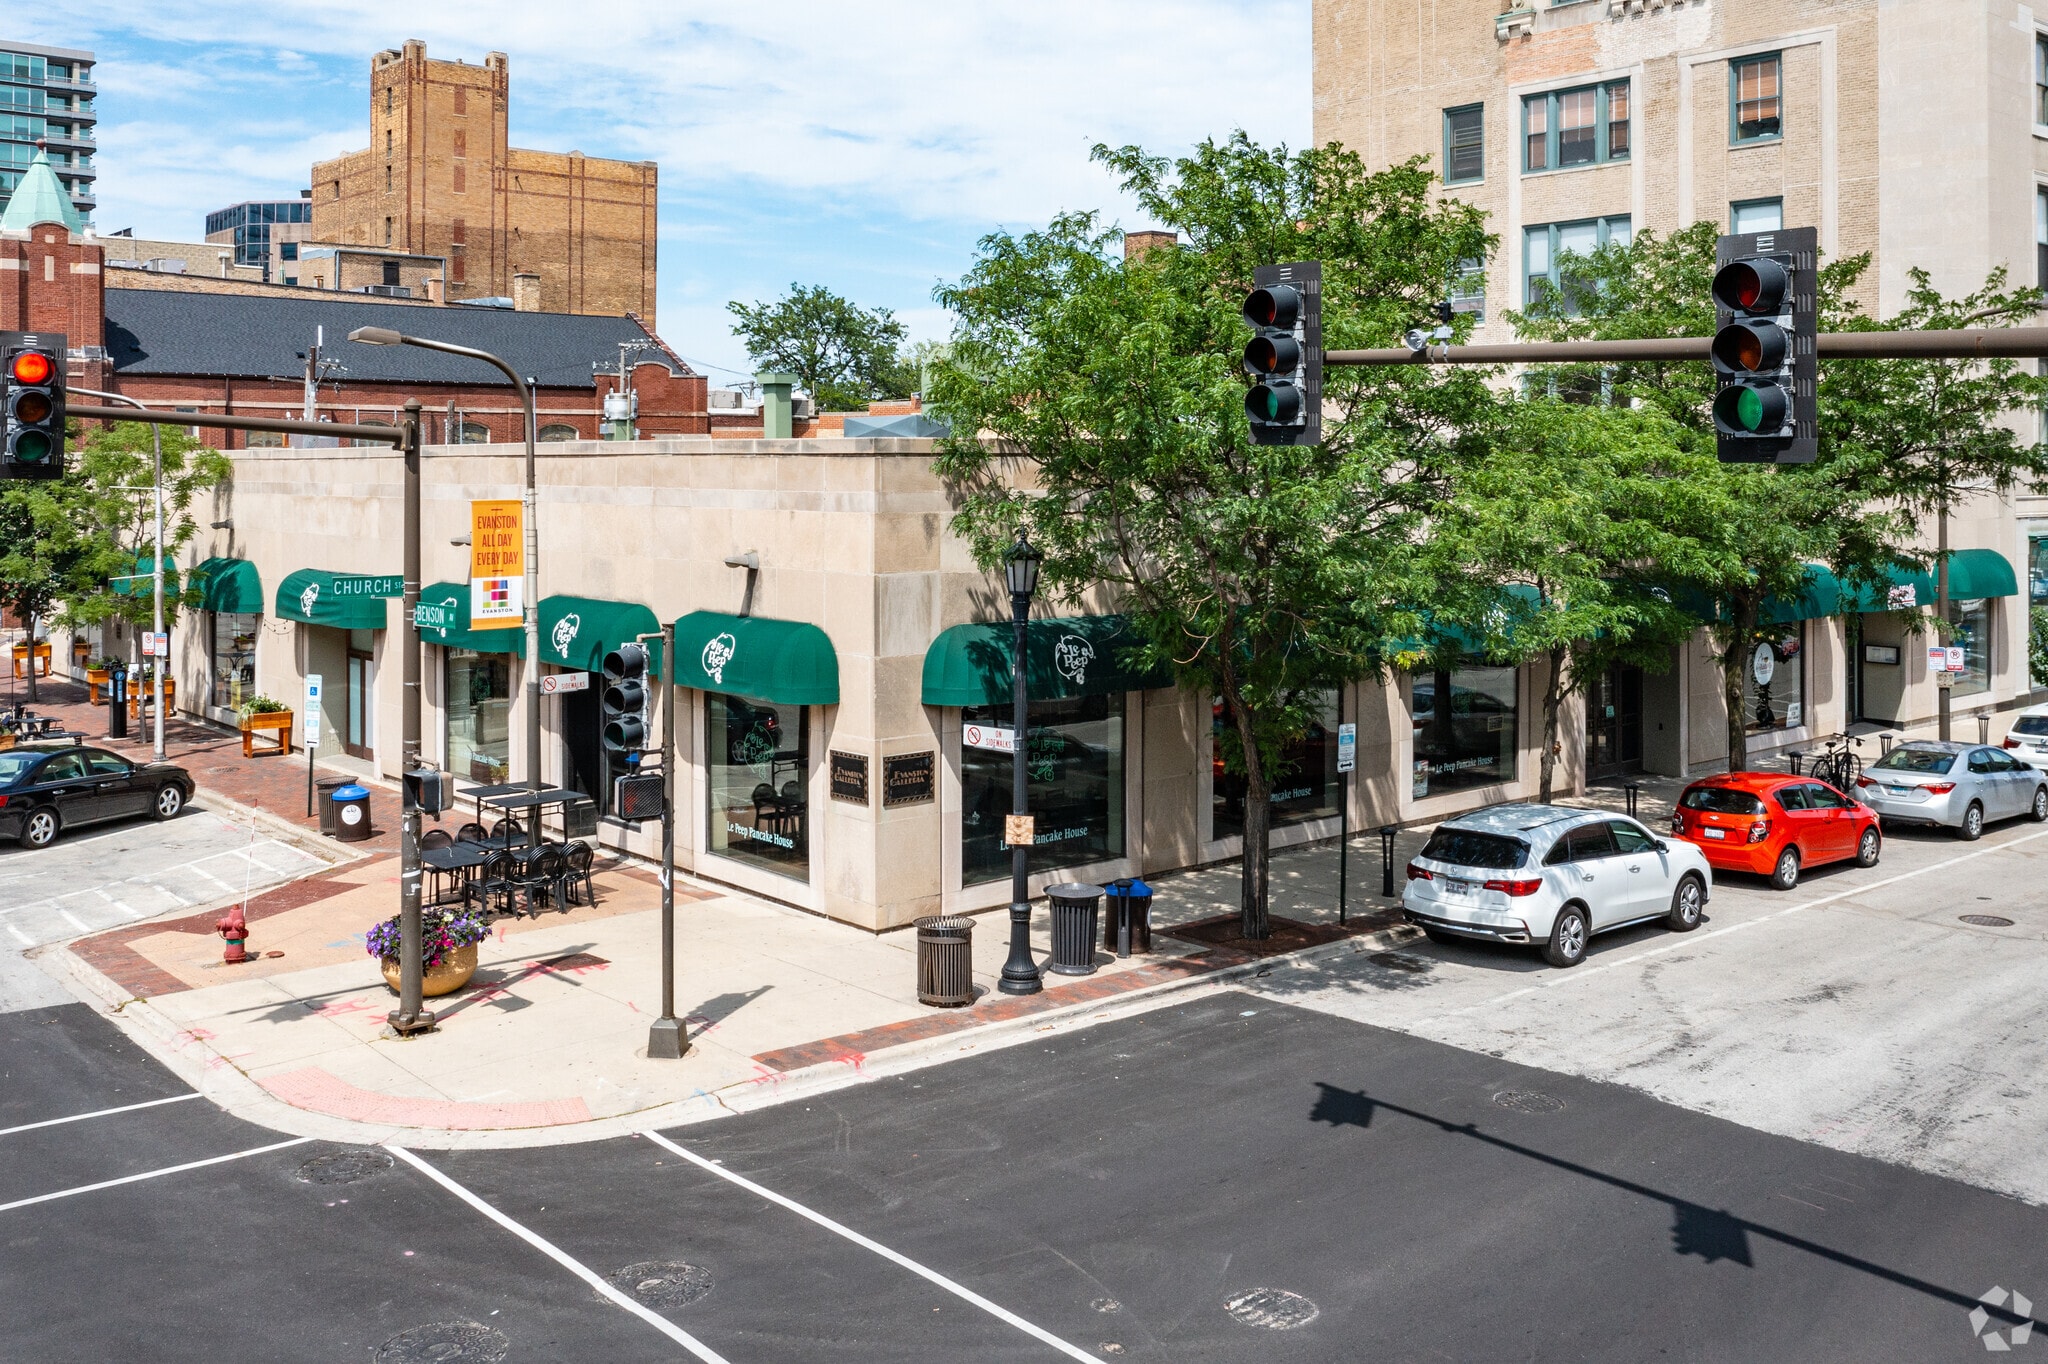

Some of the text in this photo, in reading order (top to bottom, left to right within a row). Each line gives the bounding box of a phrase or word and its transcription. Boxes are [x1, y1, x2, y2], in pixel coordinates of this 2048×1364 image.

[478, 516, 517, 530] EVANSTON
[482, 534, 512, 548] ALL DAY
[477, 552, 518, 566] EVERY DAY
[334, 580, 391, 595] CHURCH
[417, 605, 445, 624] BENSON
[1067, 644, 1080, 656] Le
[708, 650, 726, 667] Peep
[1063, 654, 1088, 669] Peep
[995, 730, 1002, 738] ON
[986, 738, 1012, 748] SIDEWALKS
[1443, 762, 1456, 773] Peep
[1456, 758, 1477, 770] Pancake
[1477, 756, 1493, 766] House
[1292, 787, 1312, 798] House
[727, 821, 793, 848] Le Peep Pancake House
[1064, 826, 1088, 839] House
